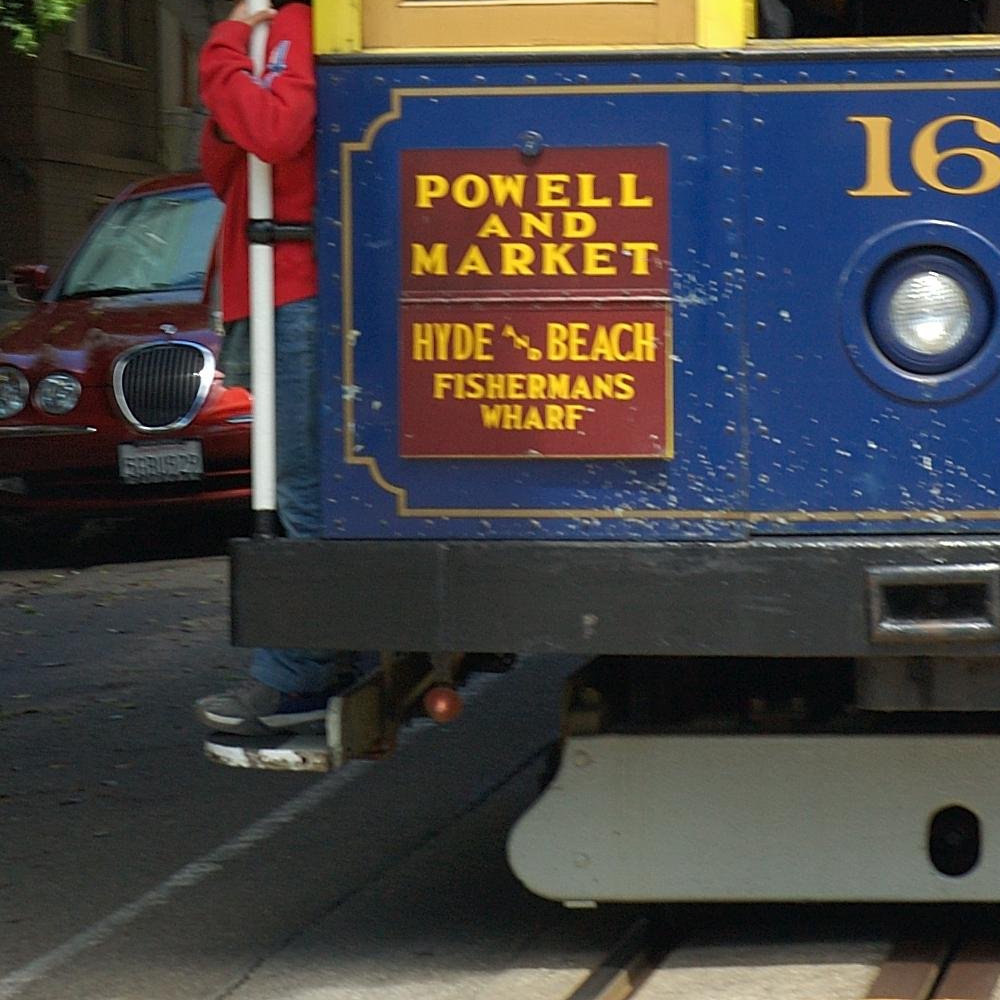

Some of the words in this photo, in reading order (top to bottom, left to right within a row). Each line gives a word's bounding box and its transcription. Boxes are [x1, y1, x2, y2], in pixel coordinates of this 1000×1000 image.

[414, 173, 654, 208] POWELL
[476, 211, 598, 238] AND
[410, 242, 659, 276] MARKET
[412, 322, 495, 362] HYDE
[546, 322, 656, 362] BEACH
[433, 373, 636, 401] FISHERMANS
[480, 404, 585, 430] WHARF
